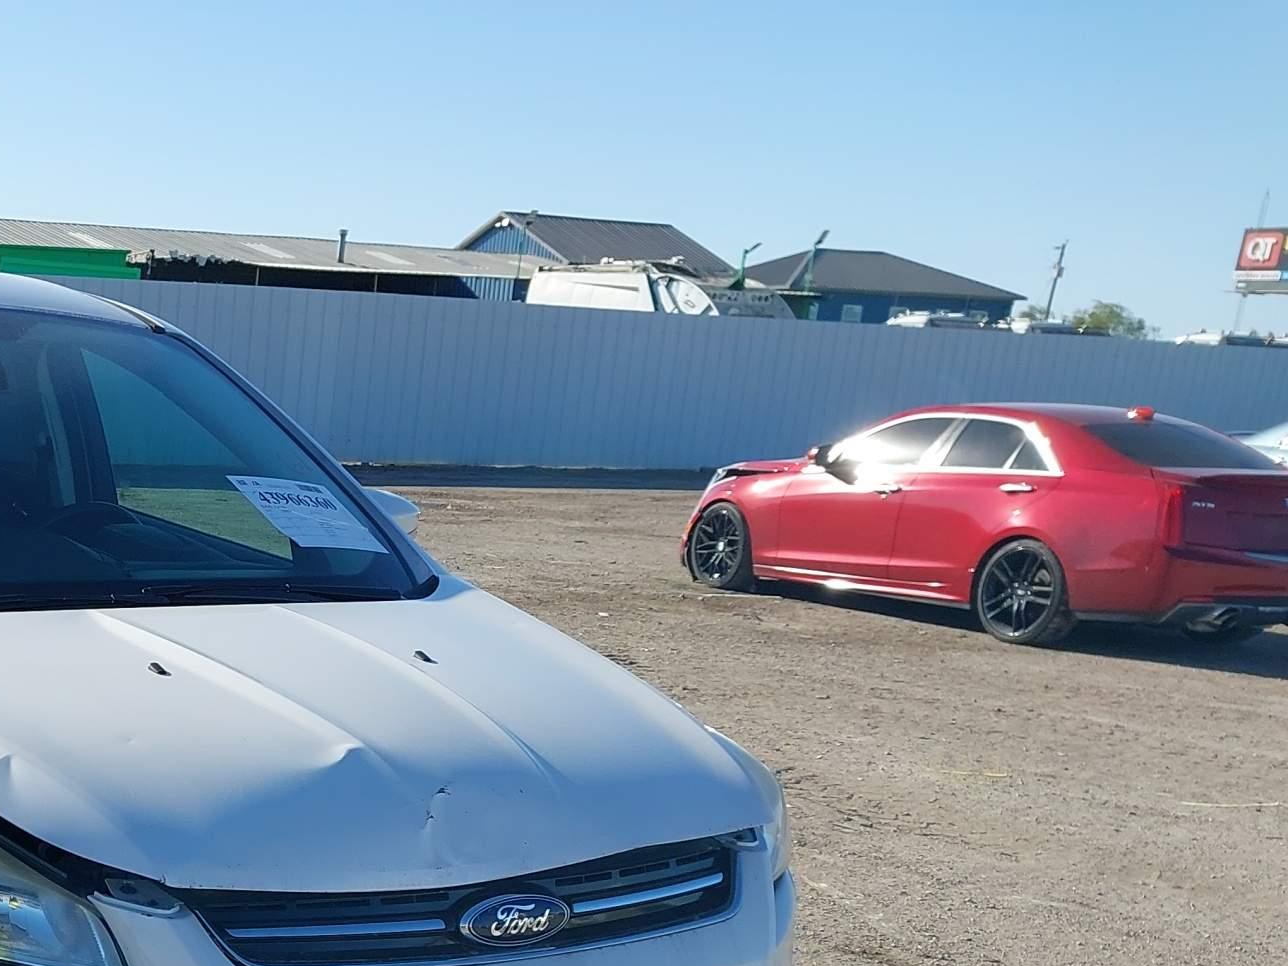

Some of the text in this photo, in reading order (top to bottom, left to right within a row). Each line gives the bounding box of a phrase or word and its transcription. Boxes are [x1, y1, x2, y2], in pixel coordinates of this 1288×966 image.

[1246, 237, 1277, 262] QT
[258, 491, 338, 512] 43966360
[490, 903, 551, 937] Ford
